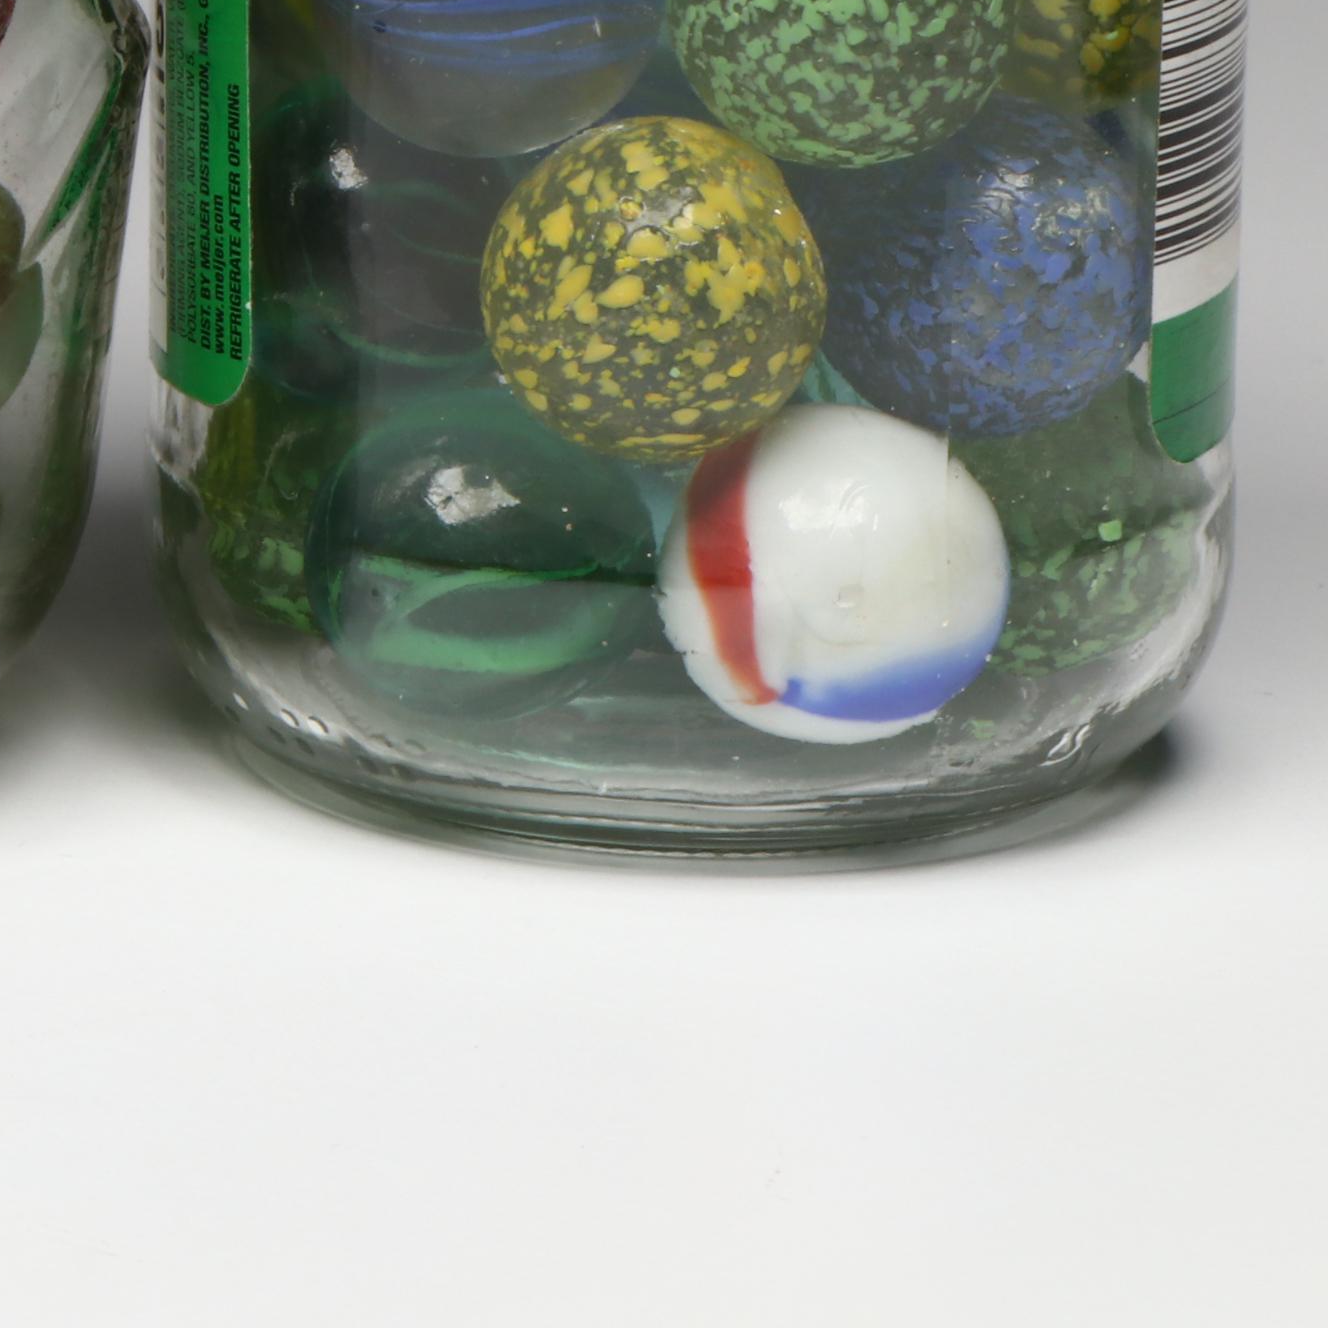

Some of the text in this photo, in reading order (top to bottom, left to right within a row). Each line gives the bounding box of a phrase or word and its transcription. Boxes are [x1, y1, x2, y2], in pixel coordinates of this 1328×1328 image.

[198, 15, 210, 56] INC.,
[185, 70, 195, 142] YELLOW
[198, 62, 210, 196] DISTRIBUTION,
[186, 148, 196, 185] AND
[199, 200, 211, 270] MEIJER
[227, 84, 242, 361] REFRIGERATE AFTER OPENING
[199, 273, 211, 301] BY
[213, 194, 225, 354] www.meijer.com
[199, 304, 211, 350] DIST.
